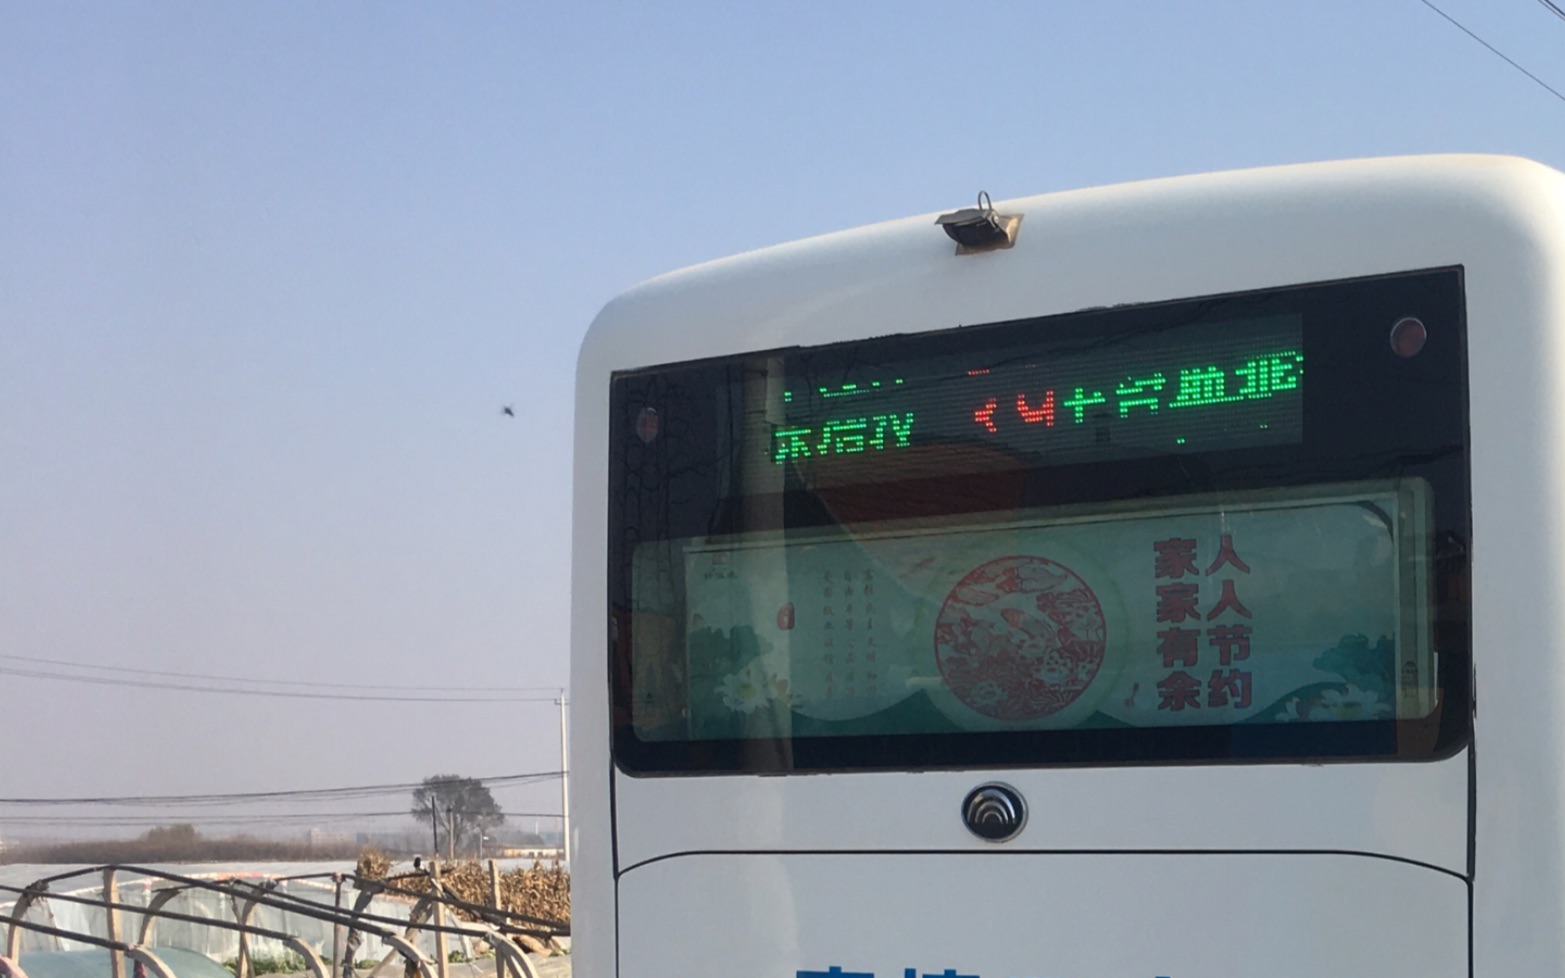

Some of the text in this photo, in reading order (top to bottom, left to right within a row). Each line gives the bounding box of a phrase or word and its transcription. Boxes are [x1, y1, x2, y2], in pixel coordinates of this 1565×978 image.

[1154, 537, 1202, 712] 家家有余
[1205, 534, 1253, 709] 人人节约
